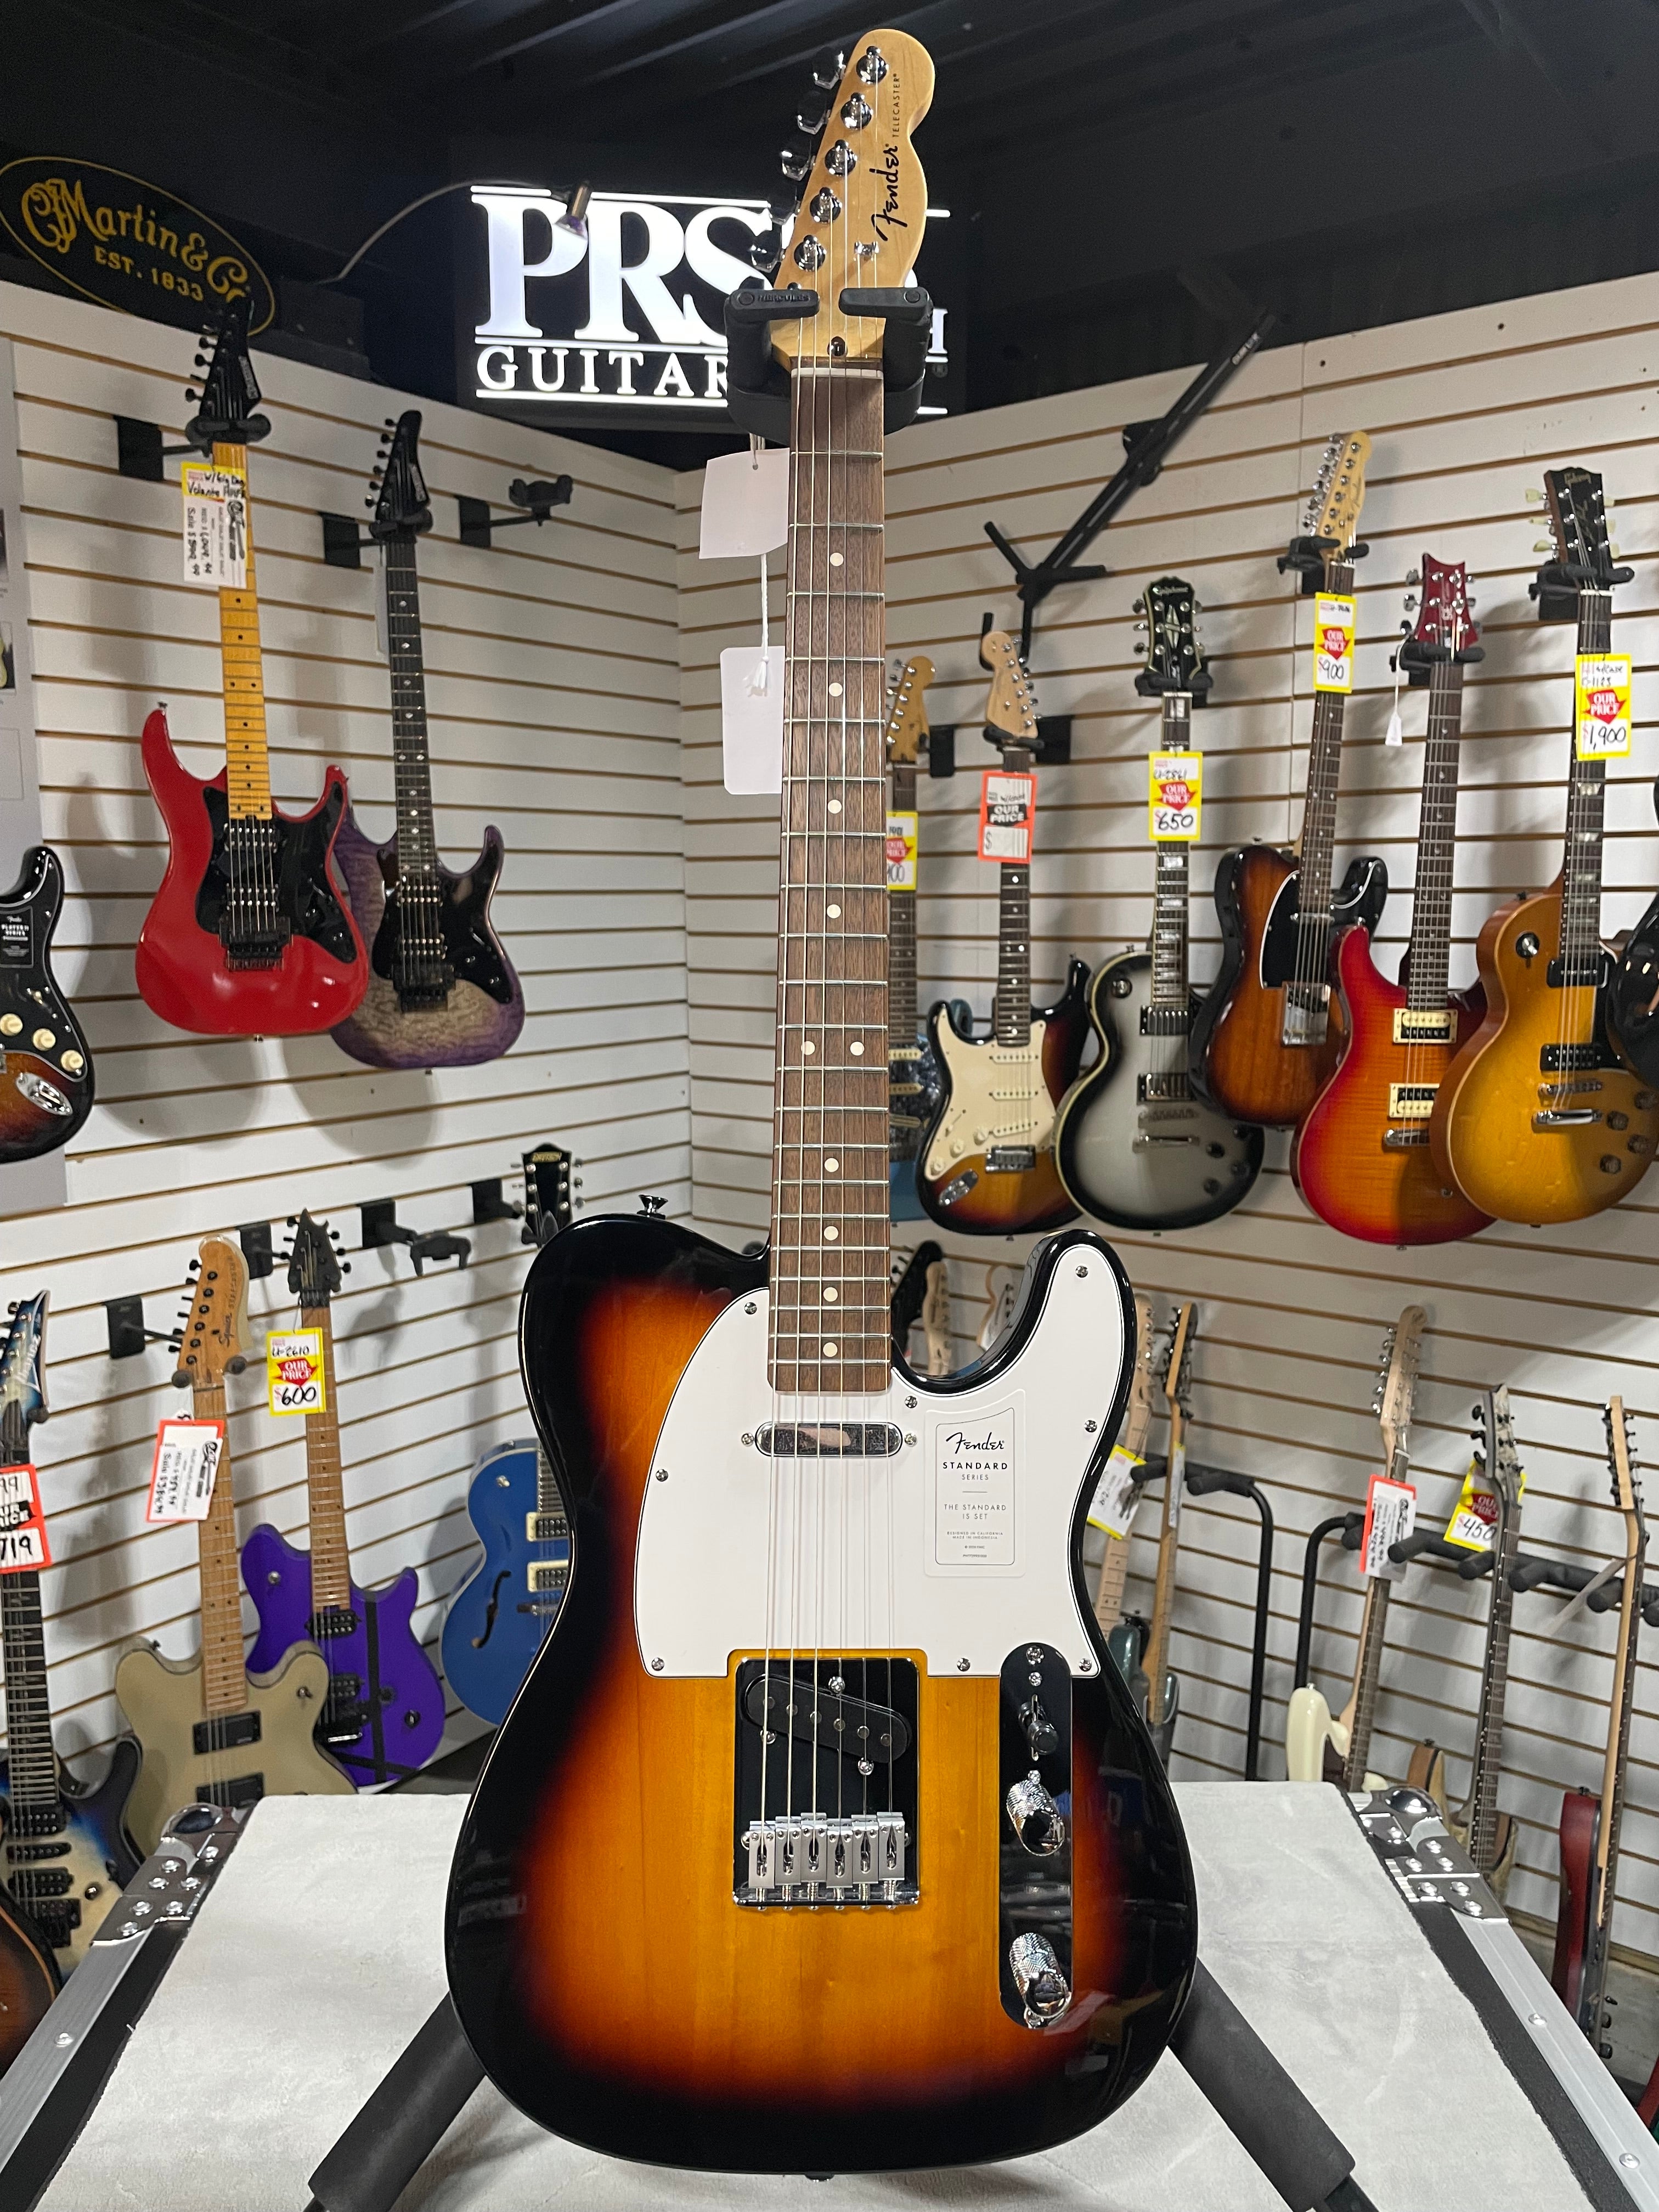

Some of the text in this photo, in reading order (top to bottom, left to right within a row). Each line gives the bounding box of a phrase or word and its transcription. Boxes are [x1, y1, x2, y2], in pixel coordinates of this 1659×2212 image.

[892, 78, 900, 138] TELECASTER
[870, 145, 908, 241] Fender
[95, 245, 204, 302] EST. 1833
[476, 346, 728, 398] GUITAR
[1593, 692, 1616, 704] OUR
[1590, 702, 1620, 715] PRICE
[1166, 783, 1187, 794] OUR
[1163, 794, 1190, 804] PRICE
[994, 805, 1019, 815] OUR
[990, 813, 1024, 823] PRICE
[285, 1360, 308, 1370] OUR
[282, 1368, 312, 1380] PRICE
[946, 1432, 1004, 1454] Fender
[943, 1462, 1007, 1470] STANDARD
